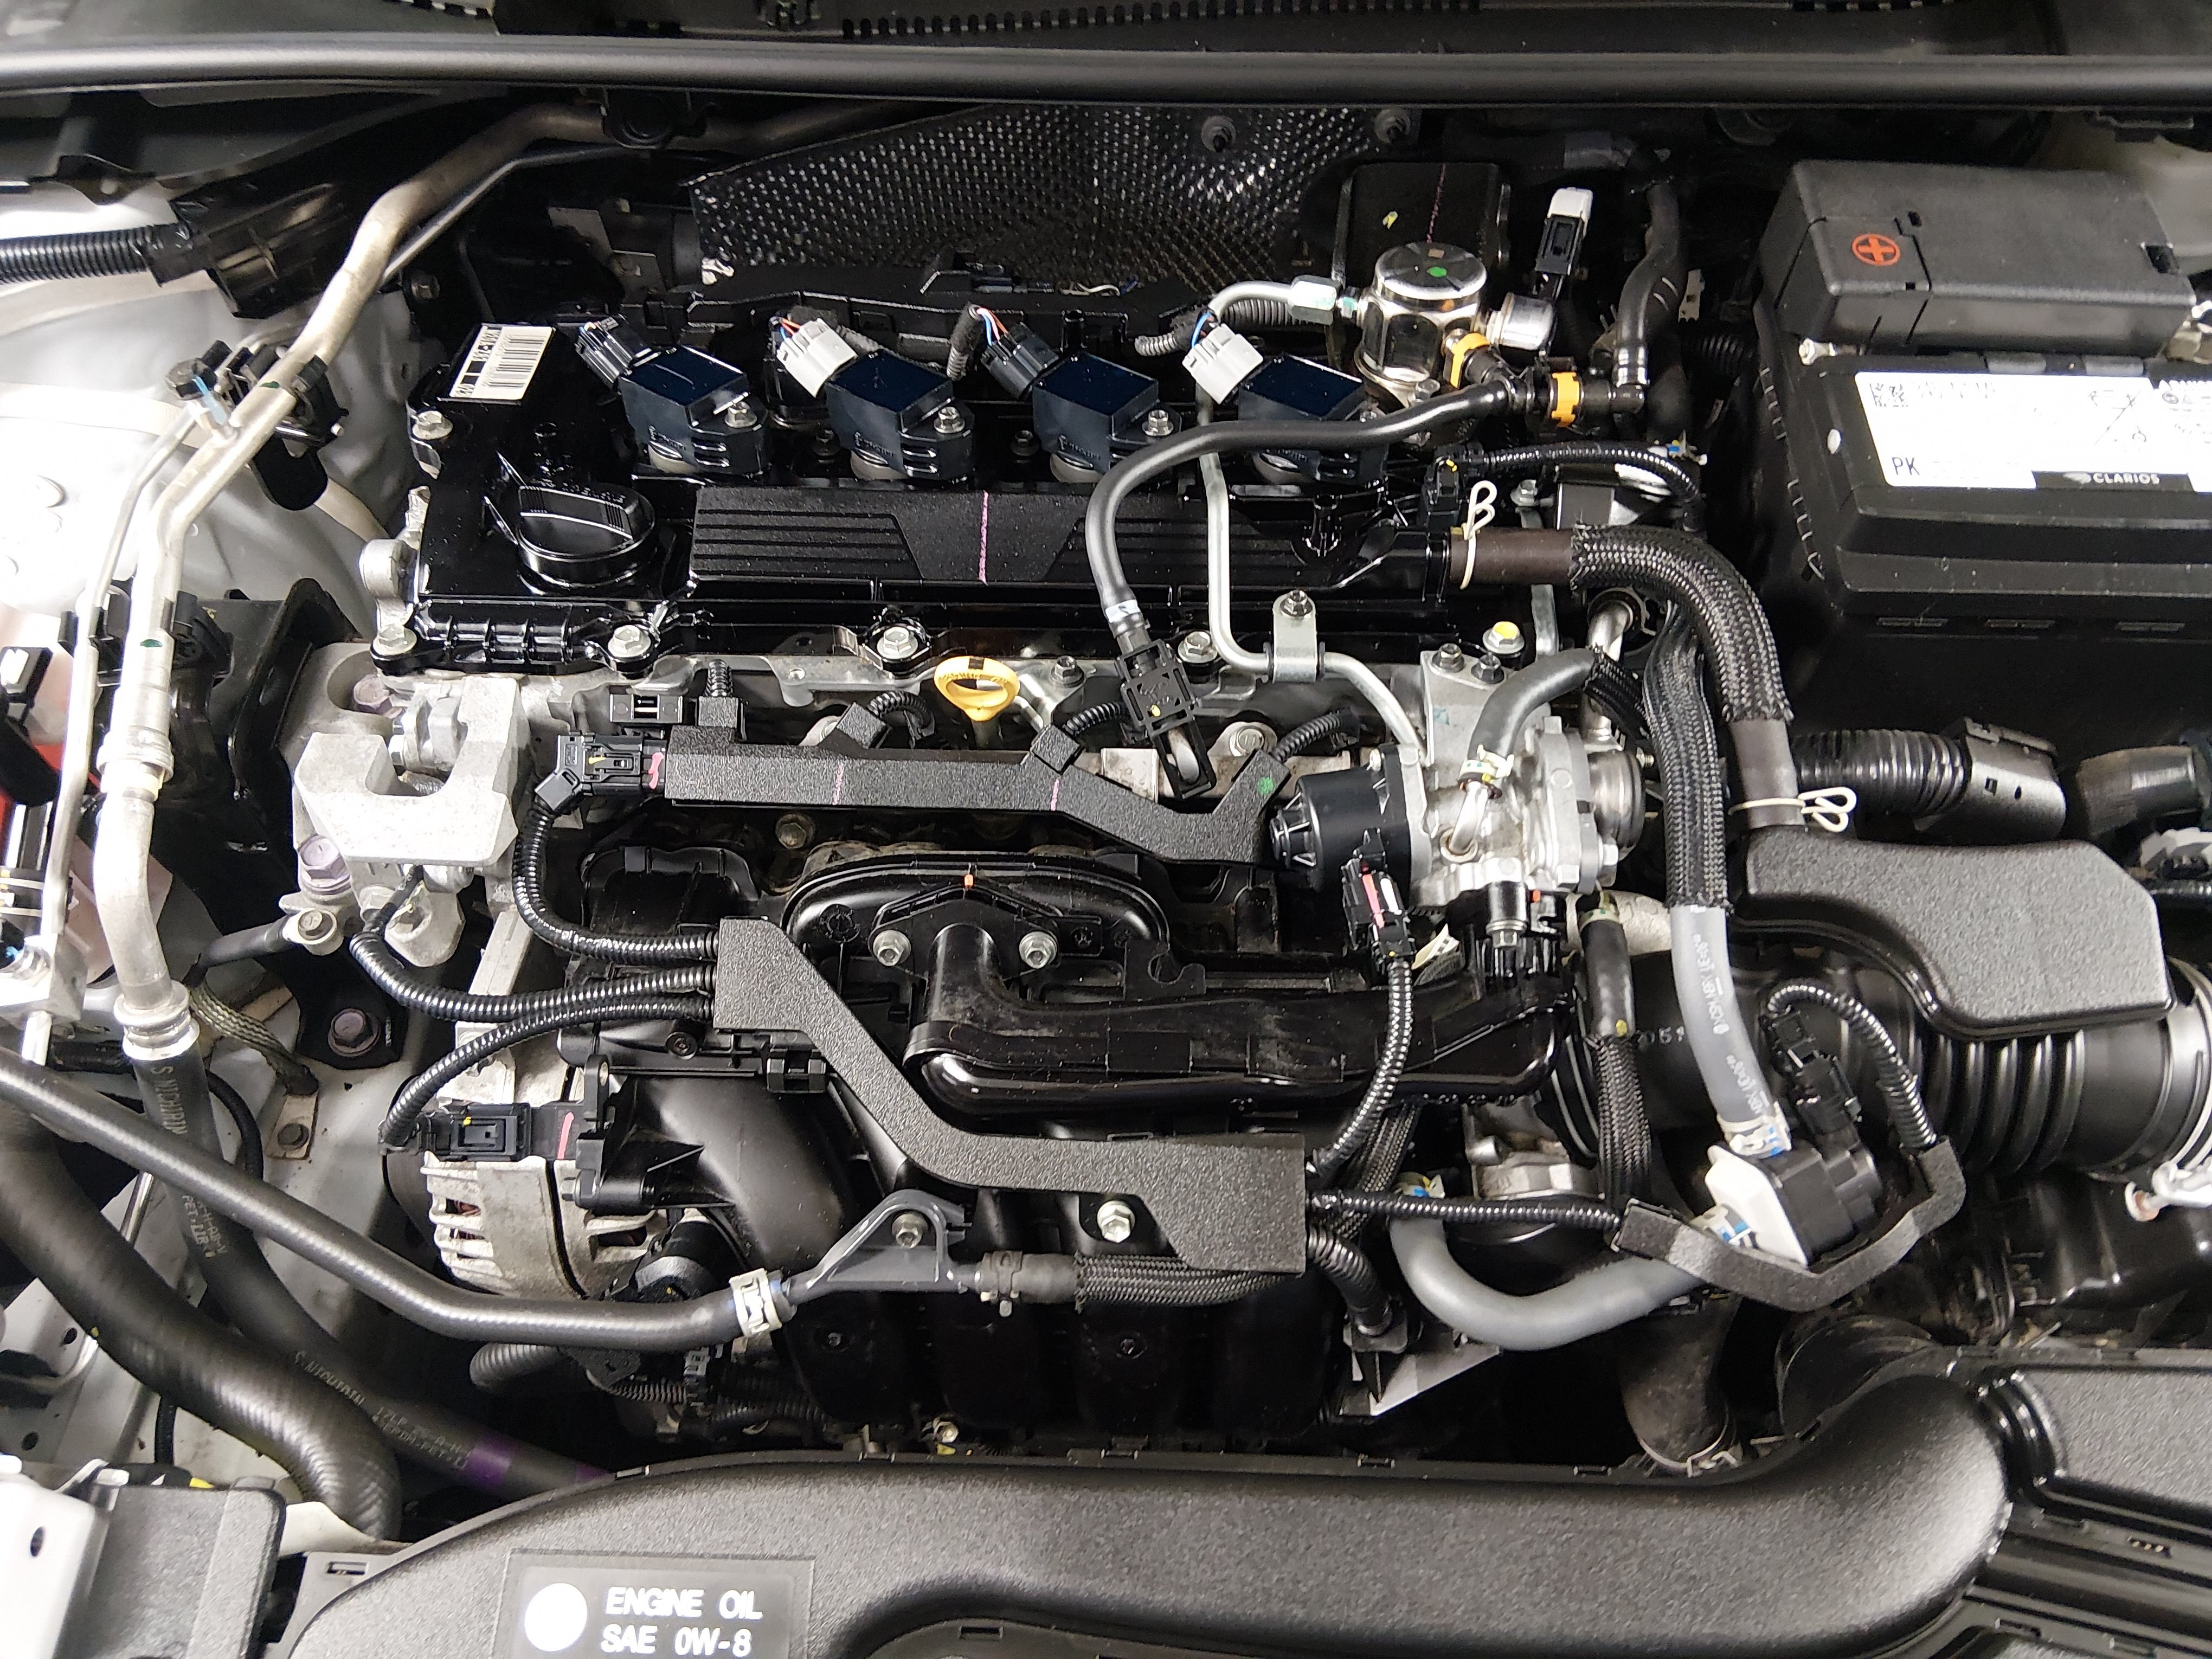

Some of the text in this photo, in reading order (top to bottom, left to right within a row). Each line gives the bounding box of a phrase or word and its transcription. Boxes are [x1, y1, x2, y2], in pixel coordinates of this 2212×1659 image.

[2093, 472, 2160, 484] CLARIOS
[605, 1586, 763, 1619] ENGINE OIL
[600, 1624, 752, 1657] SAE 0W-8
